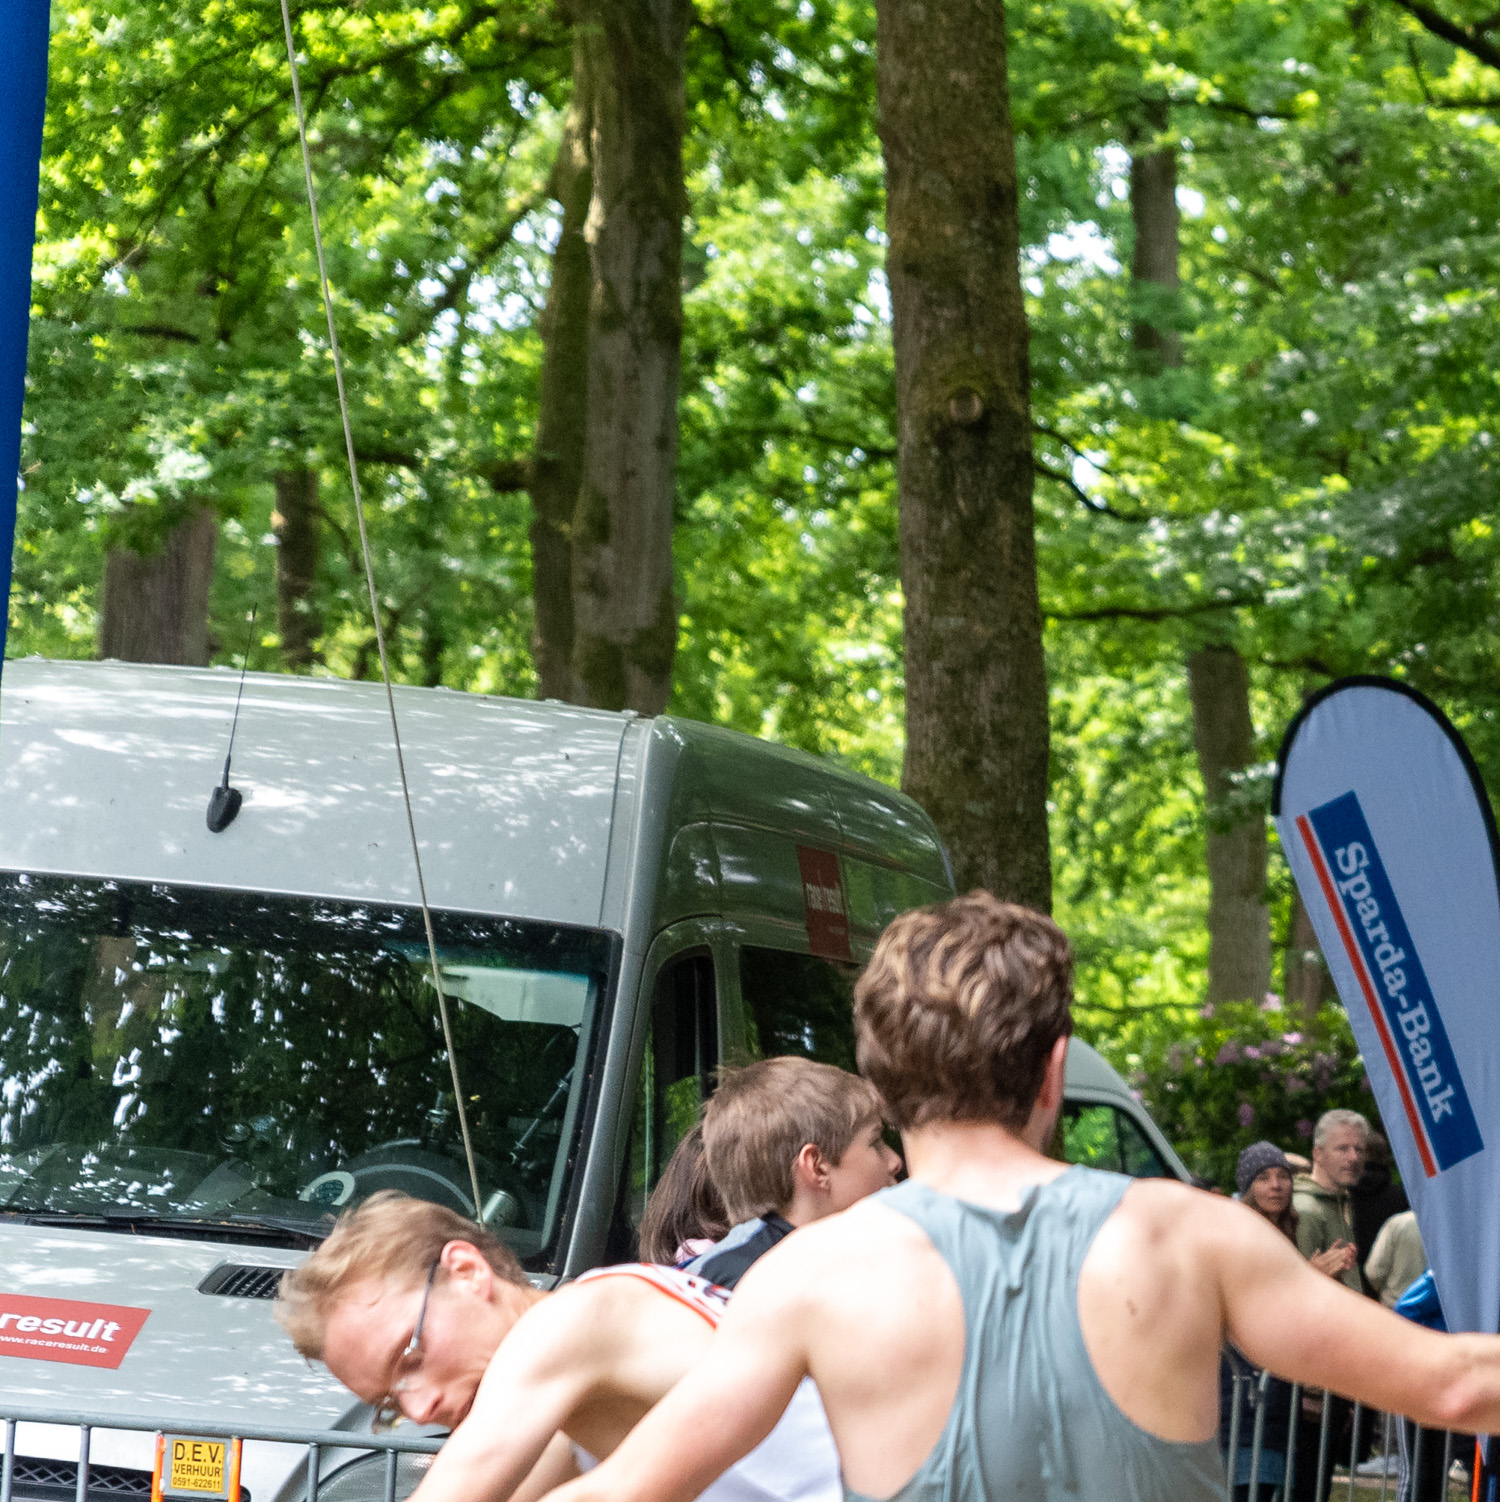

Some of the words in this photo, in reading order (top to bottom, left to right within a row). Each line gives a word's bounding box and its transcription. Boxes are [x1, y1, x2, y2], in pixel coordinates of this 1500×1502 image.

[1335, 841, 1454, 1123] Sparda-Bank
[0, 1313, 121, 1342] result
[174, 1442, 222, 1463] D.E.V.
[174, 1463, 221, 1478] VERHUUR
